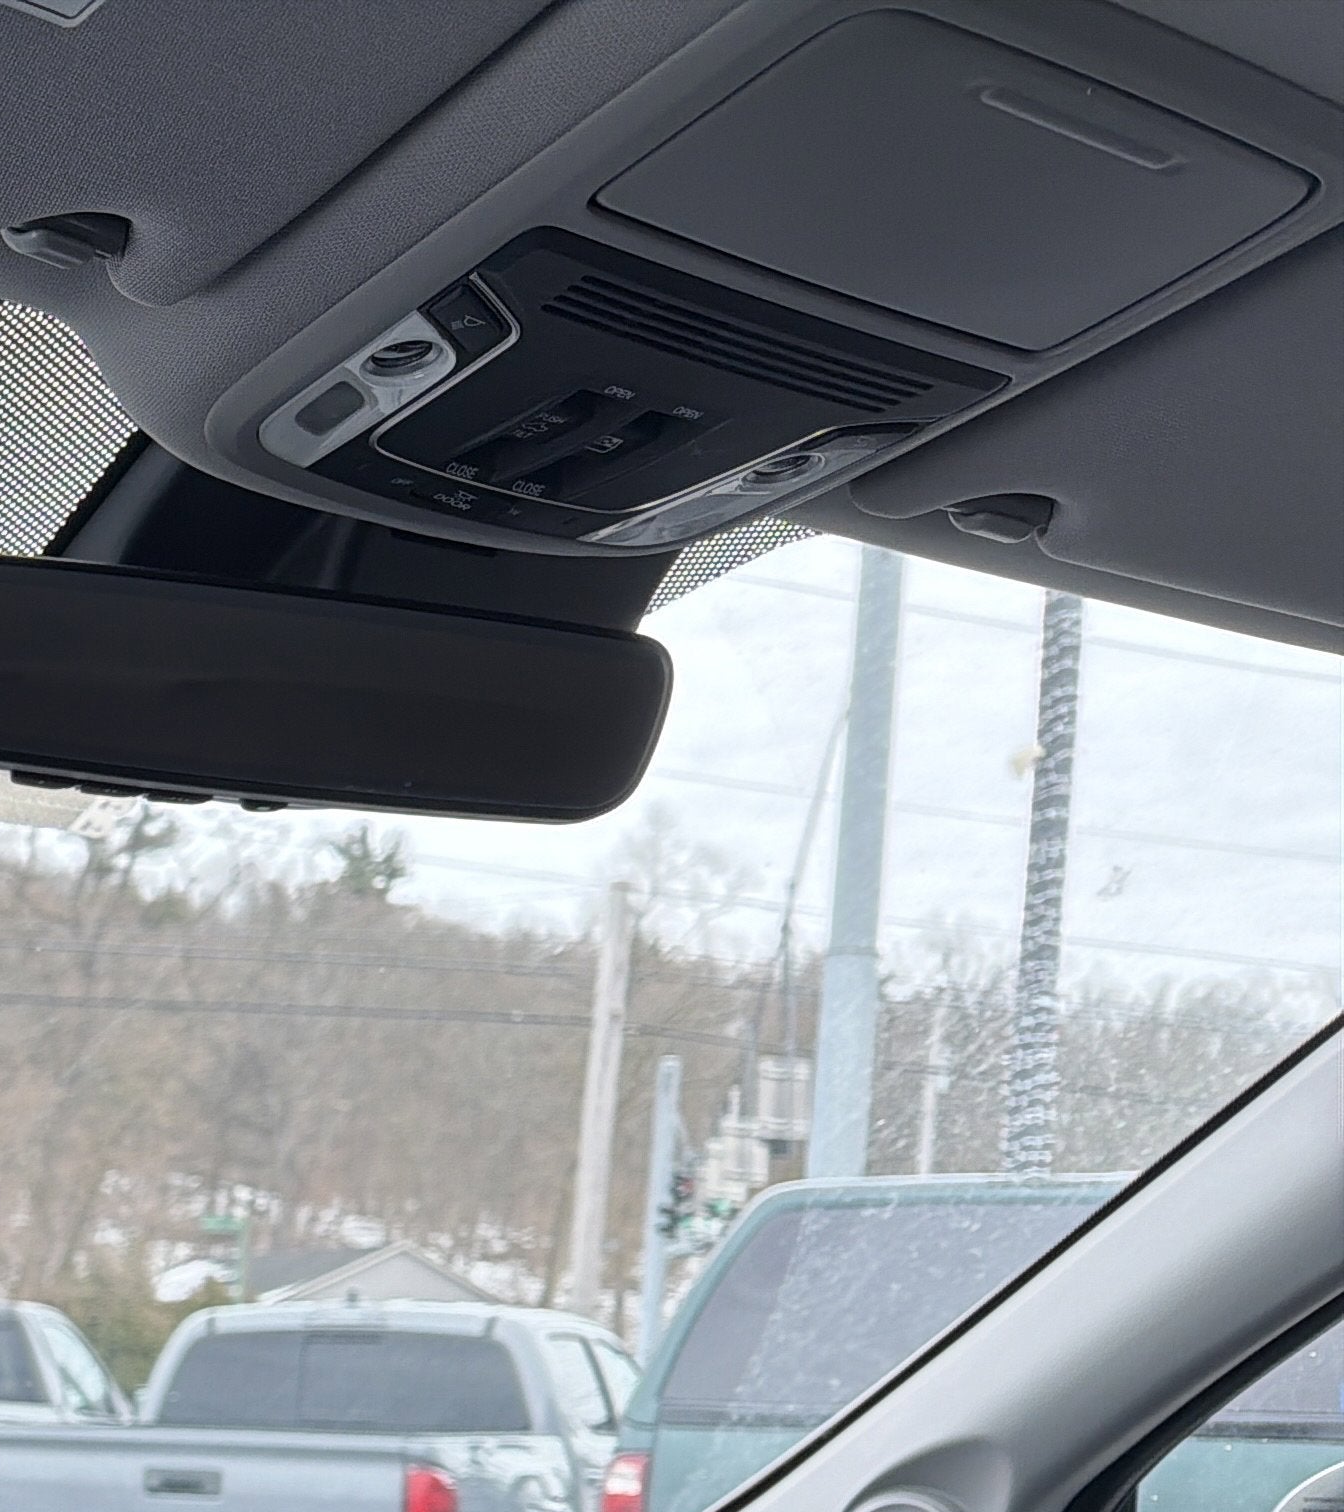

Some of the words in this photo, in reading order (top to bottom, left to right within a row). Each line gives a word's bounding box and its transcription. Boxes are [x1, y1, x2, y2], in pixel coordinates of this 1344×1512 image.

[604, 386, 635, 400] OPEN
[673, 406, 704, 420] OPEN
[446, 462, 478, 480] CLOSE
[512, 480, 545, 497] CLOSE
